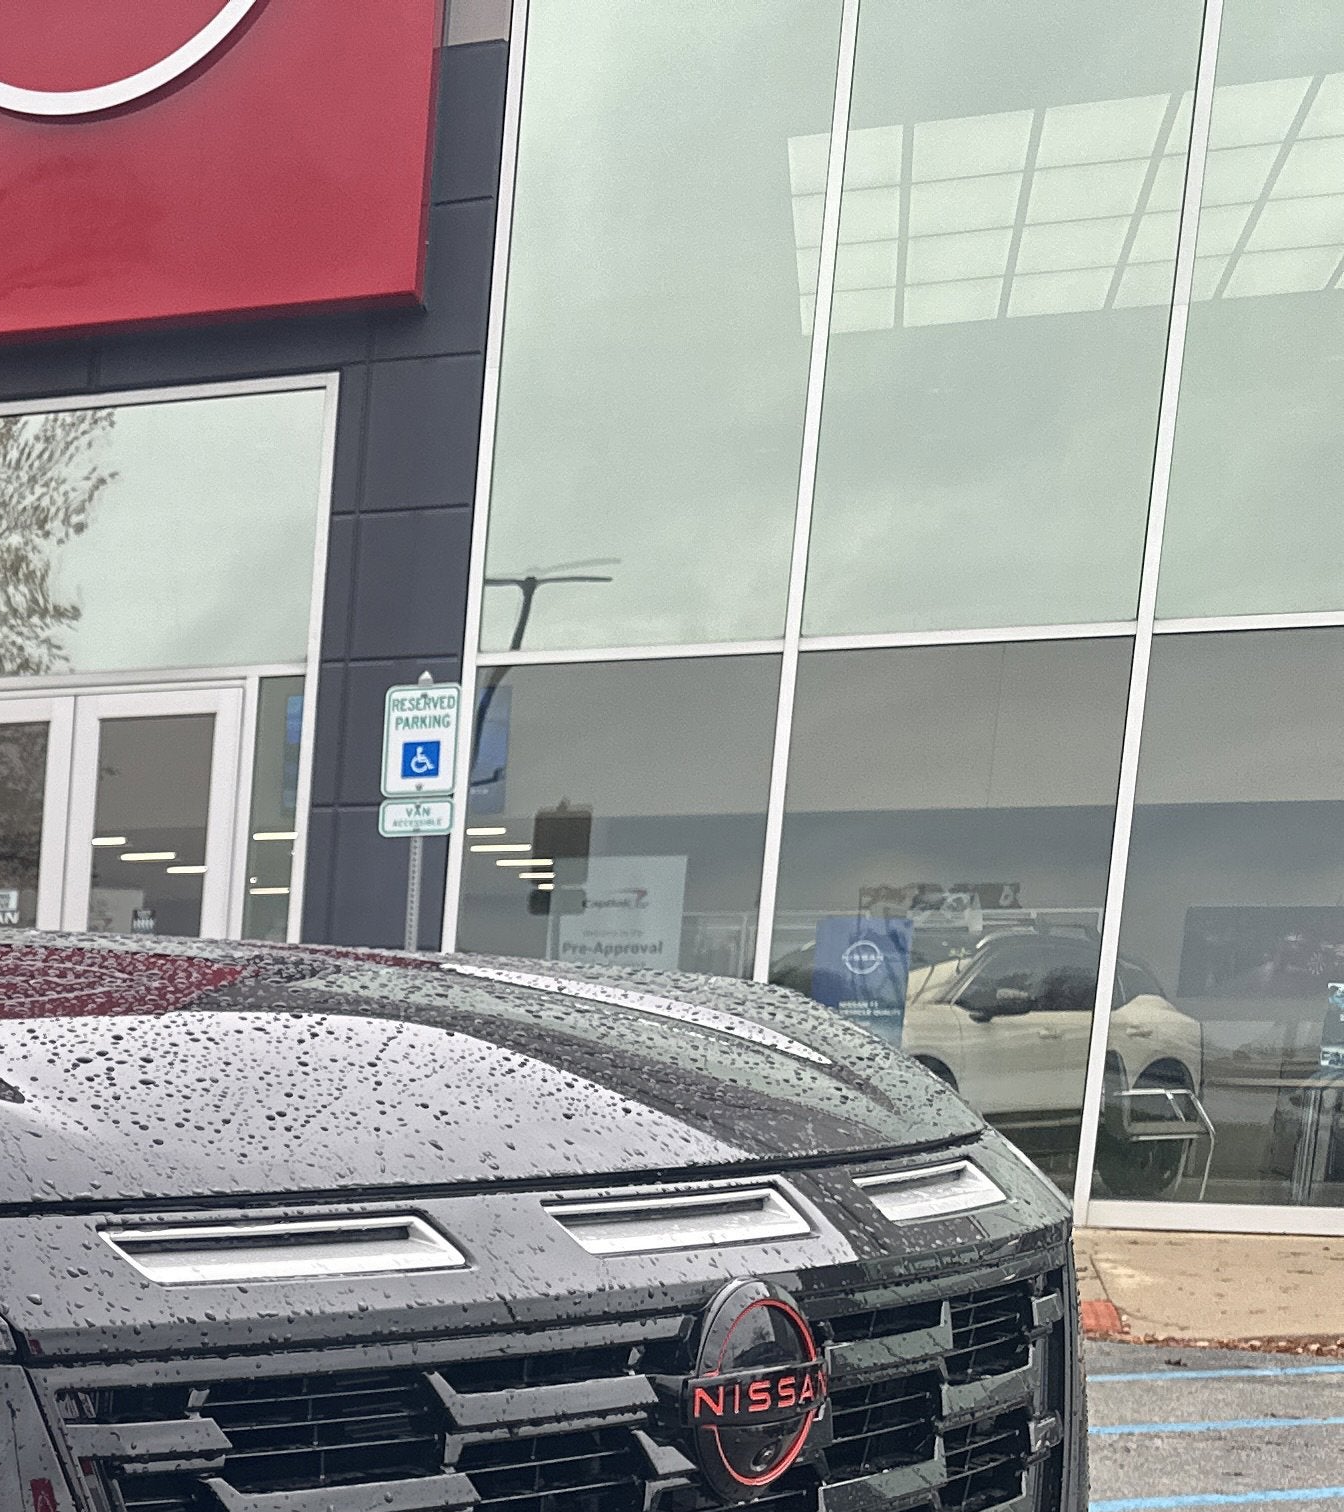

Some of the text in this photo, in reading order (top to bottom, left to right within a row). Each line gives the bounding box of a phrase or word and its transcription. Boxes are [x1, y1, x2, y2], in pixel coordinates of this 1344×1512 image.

[391, 695, 456, 712] RESERVED
[395, 713, 451, 730] PARKING
[405, 807, 431, 818] VAN
[562, 941, 664, 957] Pre-Approval
[693, 1368, 828, 1418] NISSAN
